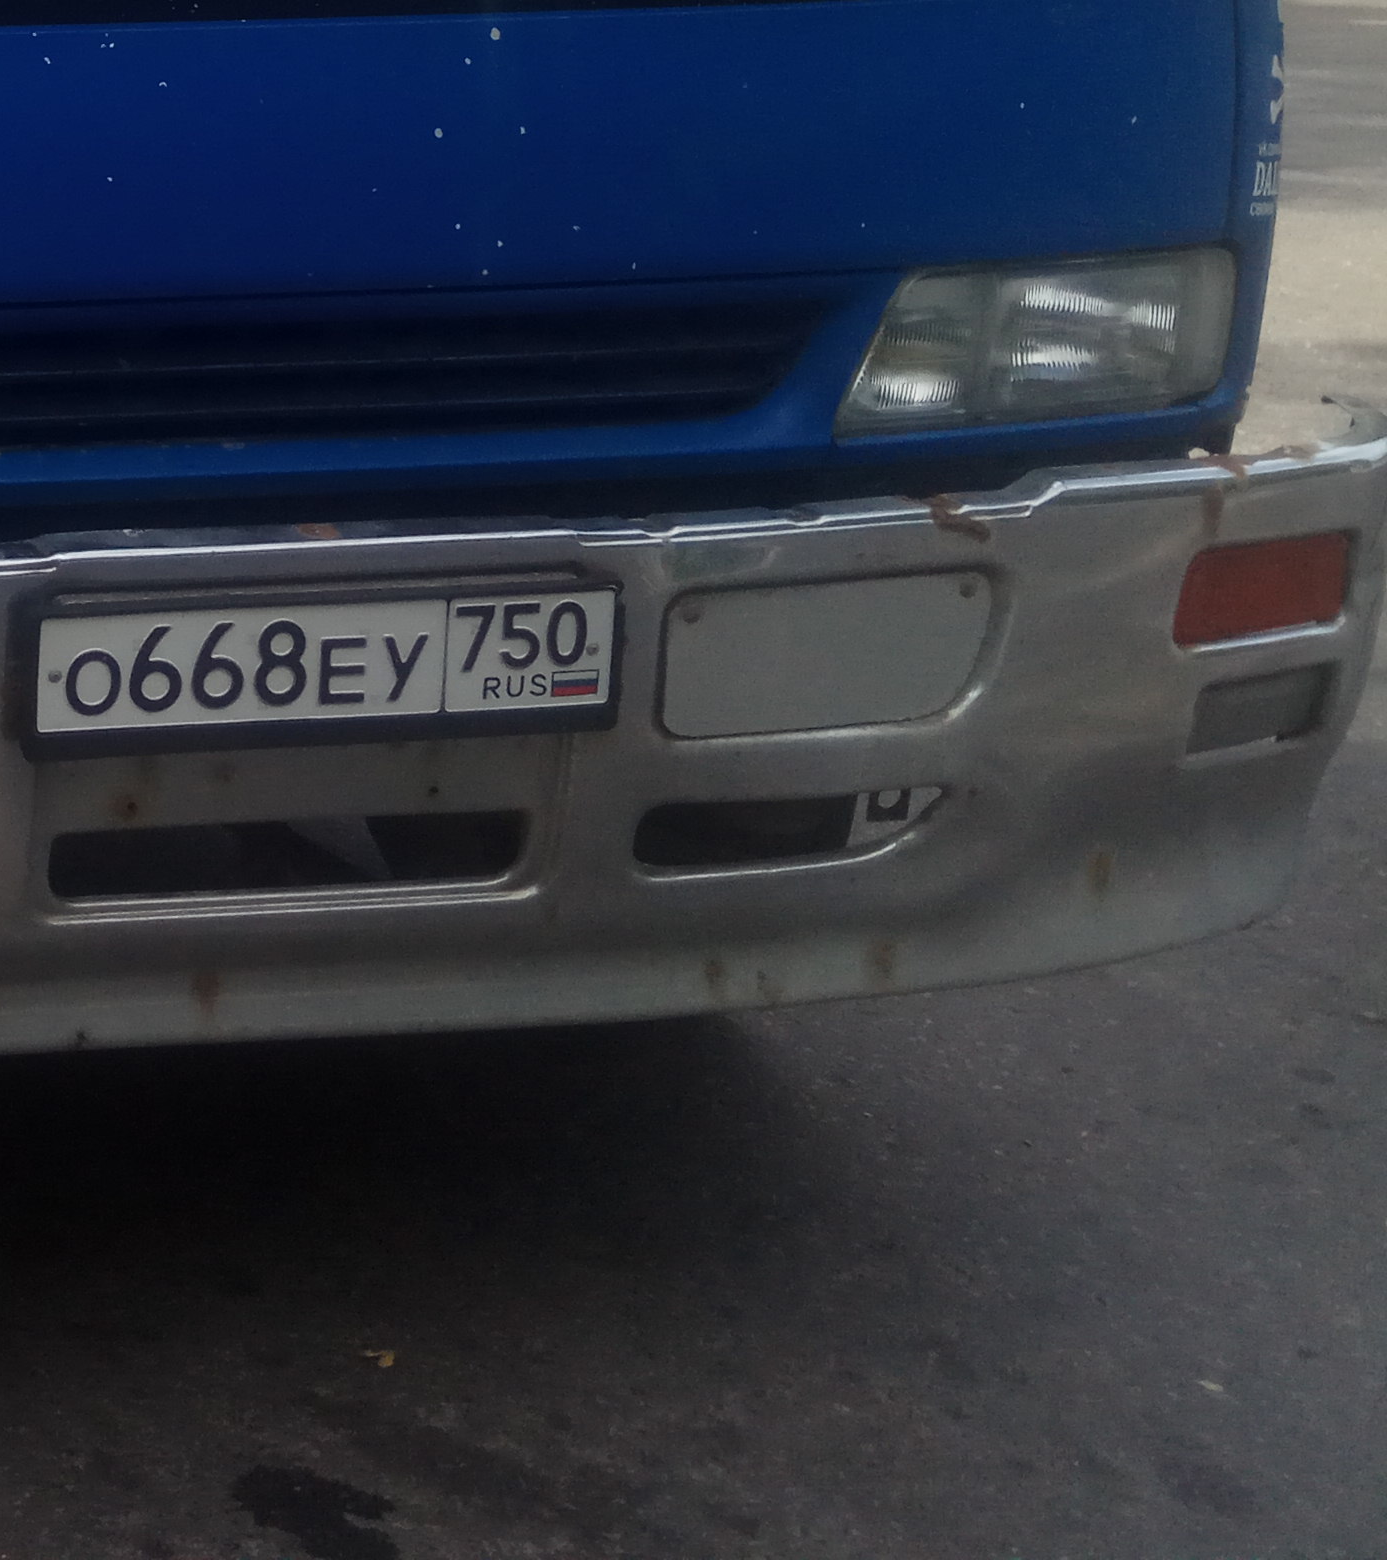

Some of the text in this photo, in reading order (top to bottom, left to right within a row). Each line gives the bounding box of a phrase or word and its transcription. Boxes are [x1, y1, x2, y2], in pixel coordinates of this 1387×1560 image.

[63, 599, 589, 716] О668ЕУ 750
[482, 673, 548, 700] RUS
